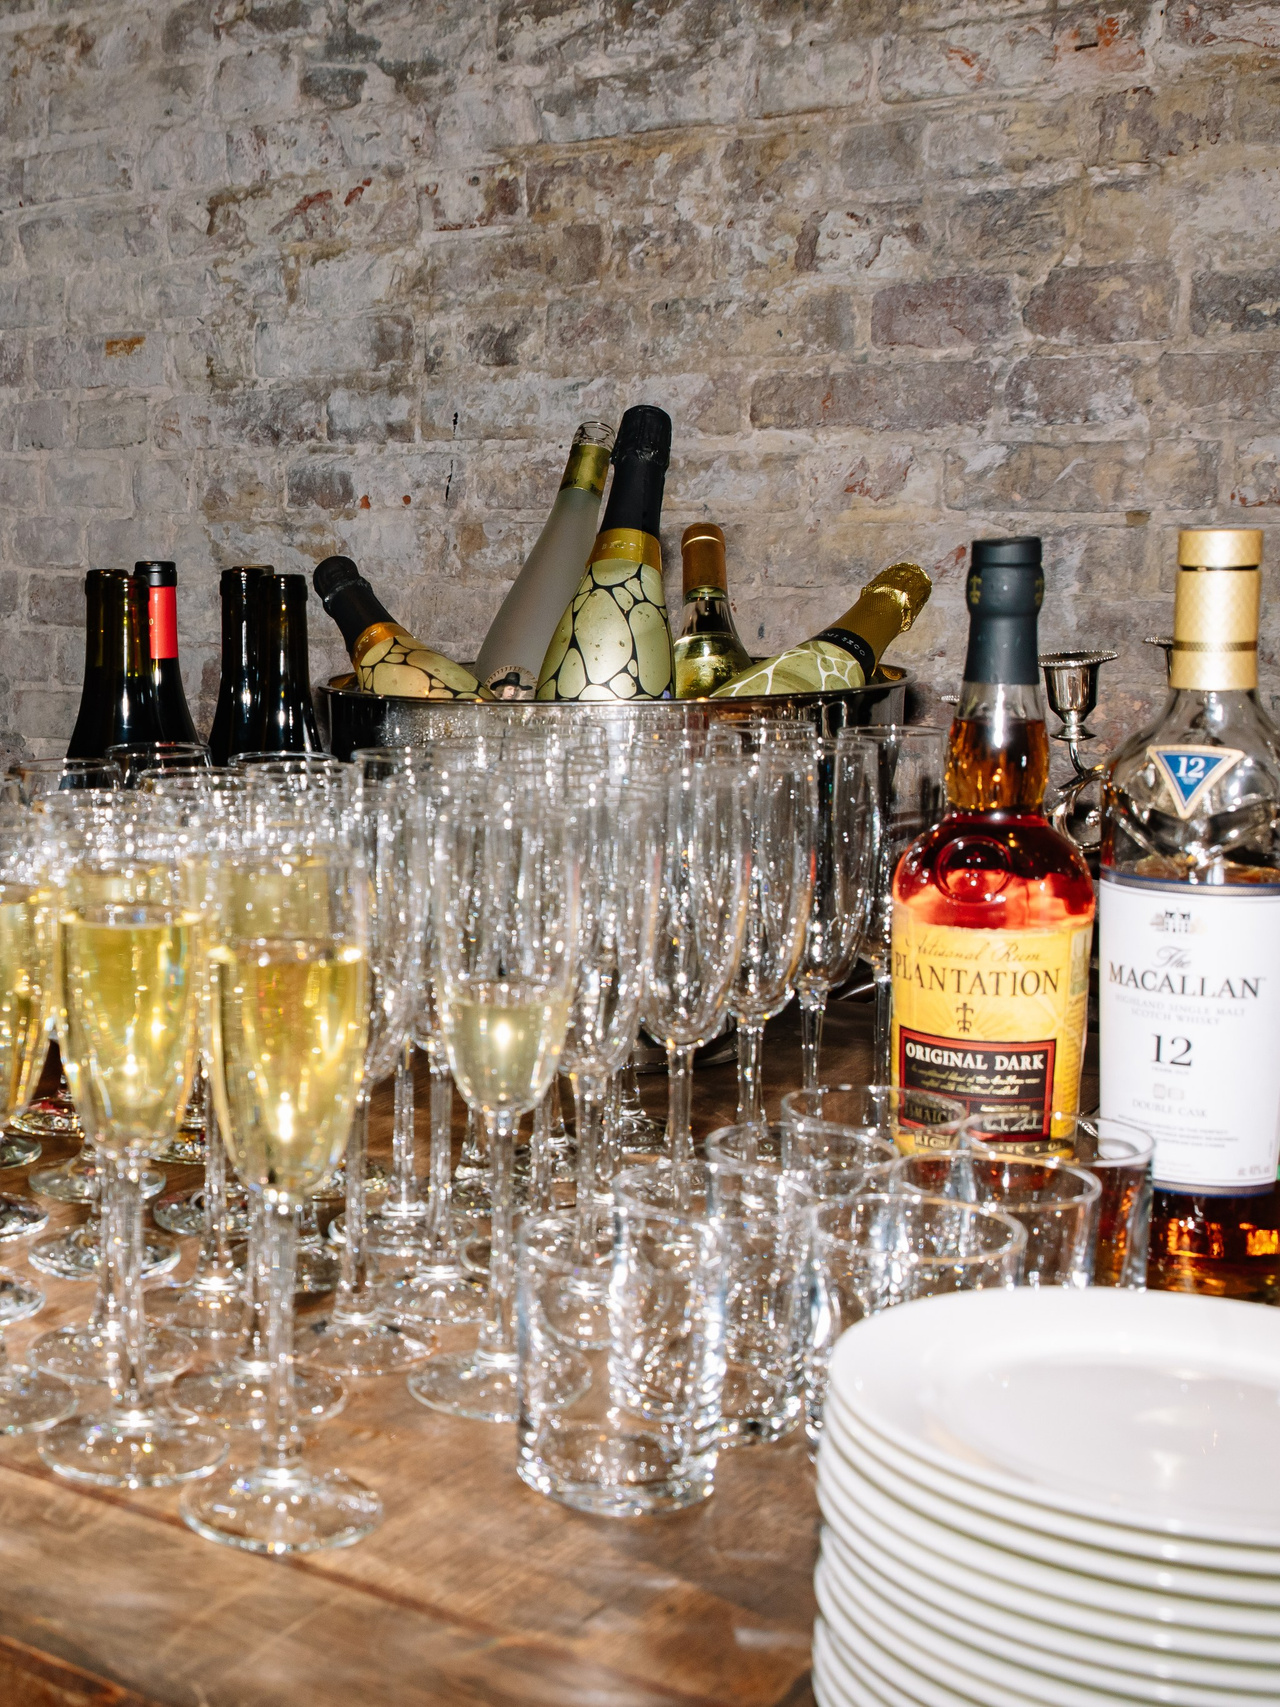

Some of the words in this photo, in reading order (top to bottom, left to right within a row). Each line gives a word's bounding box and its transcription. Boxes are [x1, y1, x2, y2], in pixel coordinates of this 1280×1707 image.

[1176, 756, 1205, 778] 12
[991, 941, 1041, 962] Rum
[1151, 945, 1192, 968] The
[894, 951, 1061, 997] PLANTATION
[1108, 961, 1262, 999] MACALLAN
[905, 1042, 988, 1070] ORIGINAL
[994, 1053, 1045, 1072] DARK
[1151, 1033, 1193, 1067] 12
